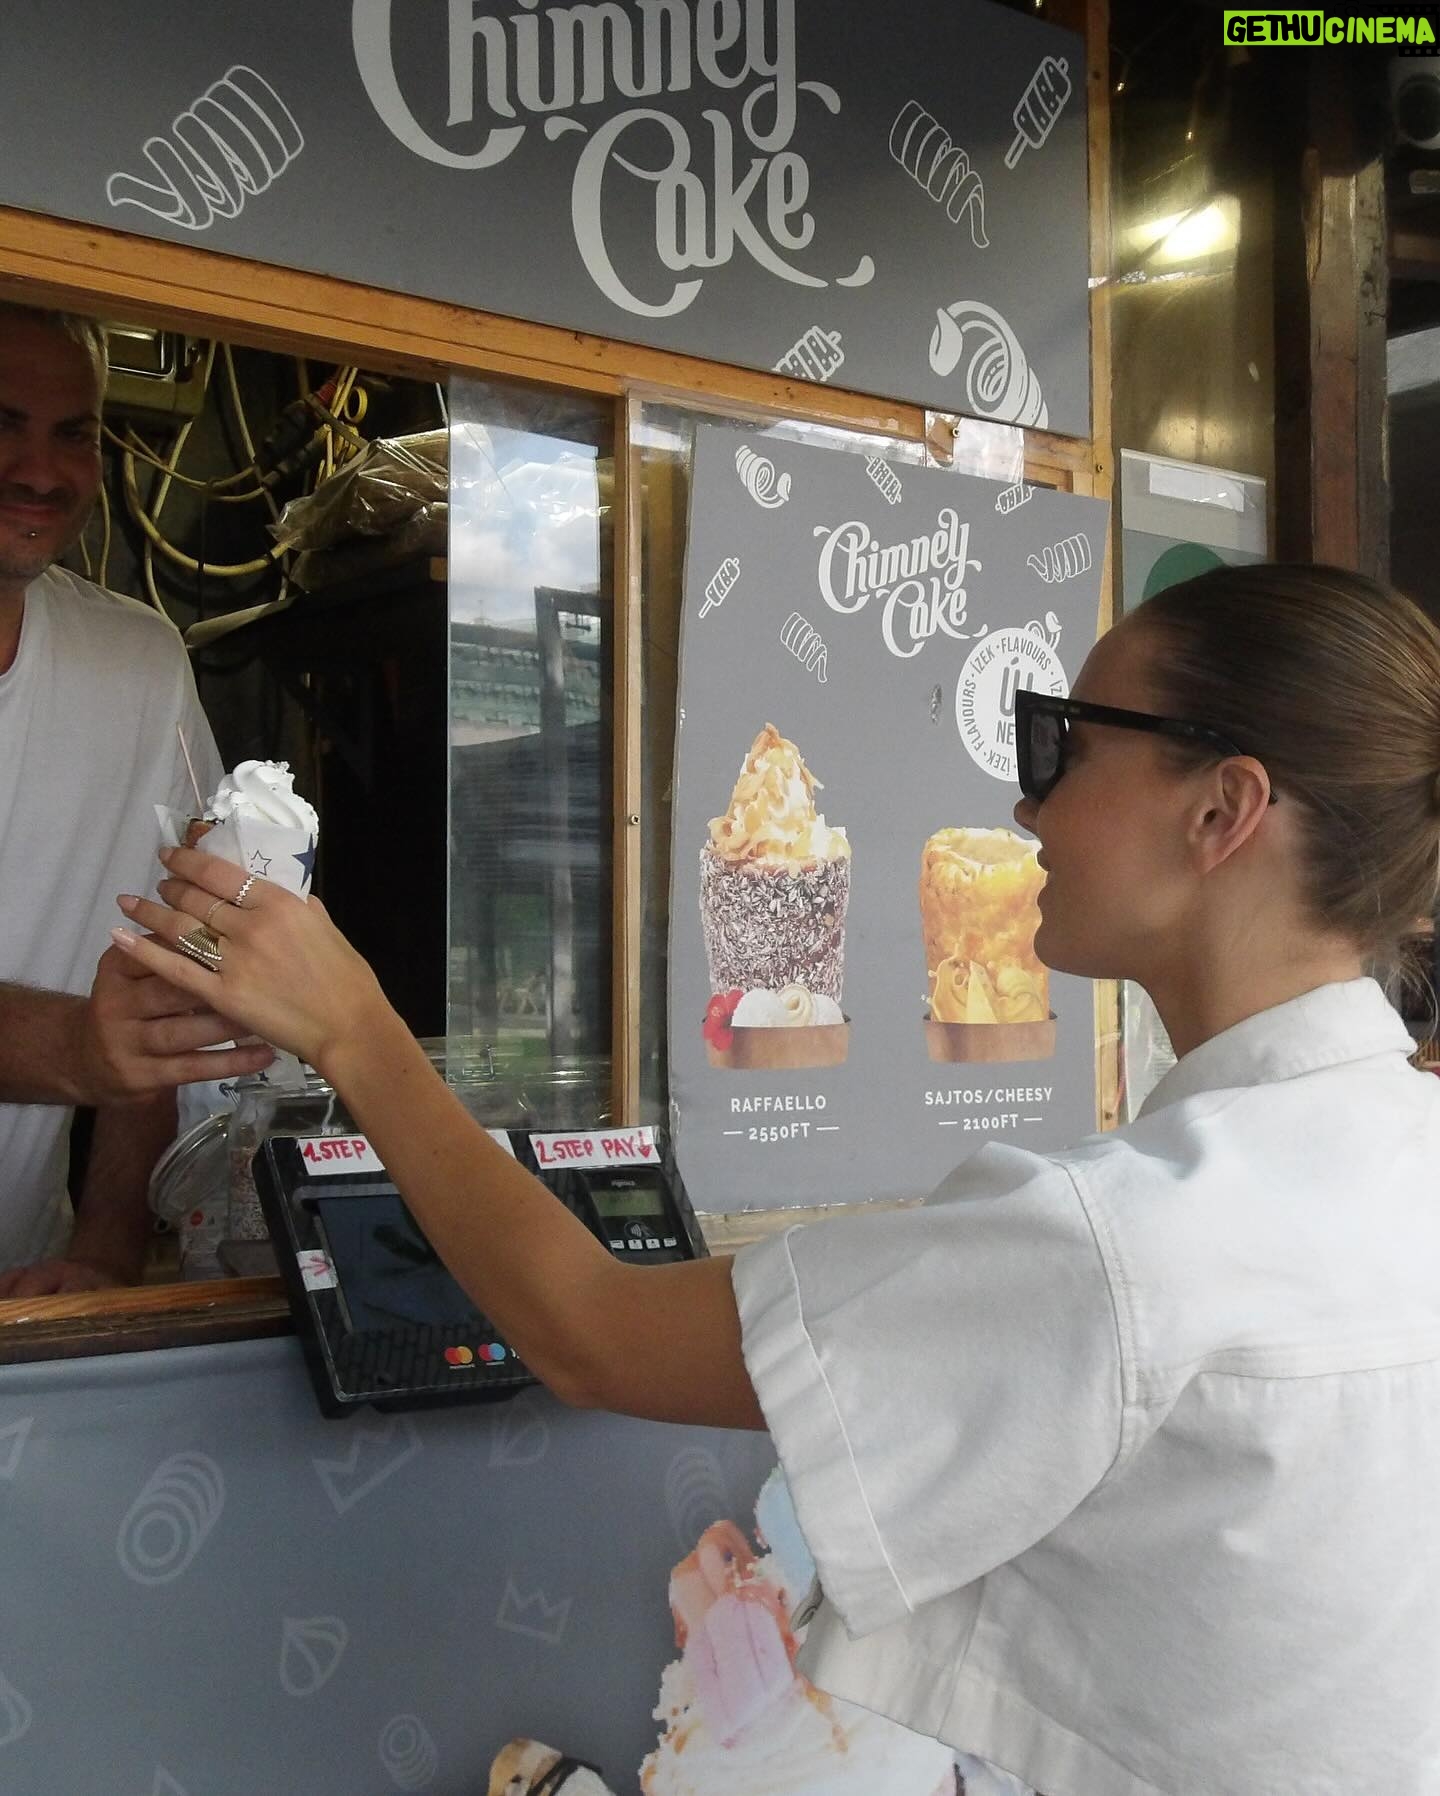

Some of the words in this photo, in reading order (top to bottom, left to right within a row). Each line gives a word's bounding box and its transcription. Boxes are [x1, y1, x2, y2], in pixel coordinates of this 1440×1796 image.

[352, 0, 840, 169] Chimney
[545, 108, 875, 317] Cake
[814, 508, 982, 613] Chimney
[876, 577, 988, 659] Cake
[962, 679, 985, 751] FLAVOURS
[1001, 636, 1051, 670] FLAVOURS
[996, 720, 1016, 746] NE
[731, 1095, 826, 1112] RAFFAELLO
[925, 1087, 1052, 1105] SAJTOS/CHEESY
[749, 1122, 810, 1142] 2550FT
[963, 1113, 1018, 1130] 2100FT
[601, 1135, 636, 1158] PAY
